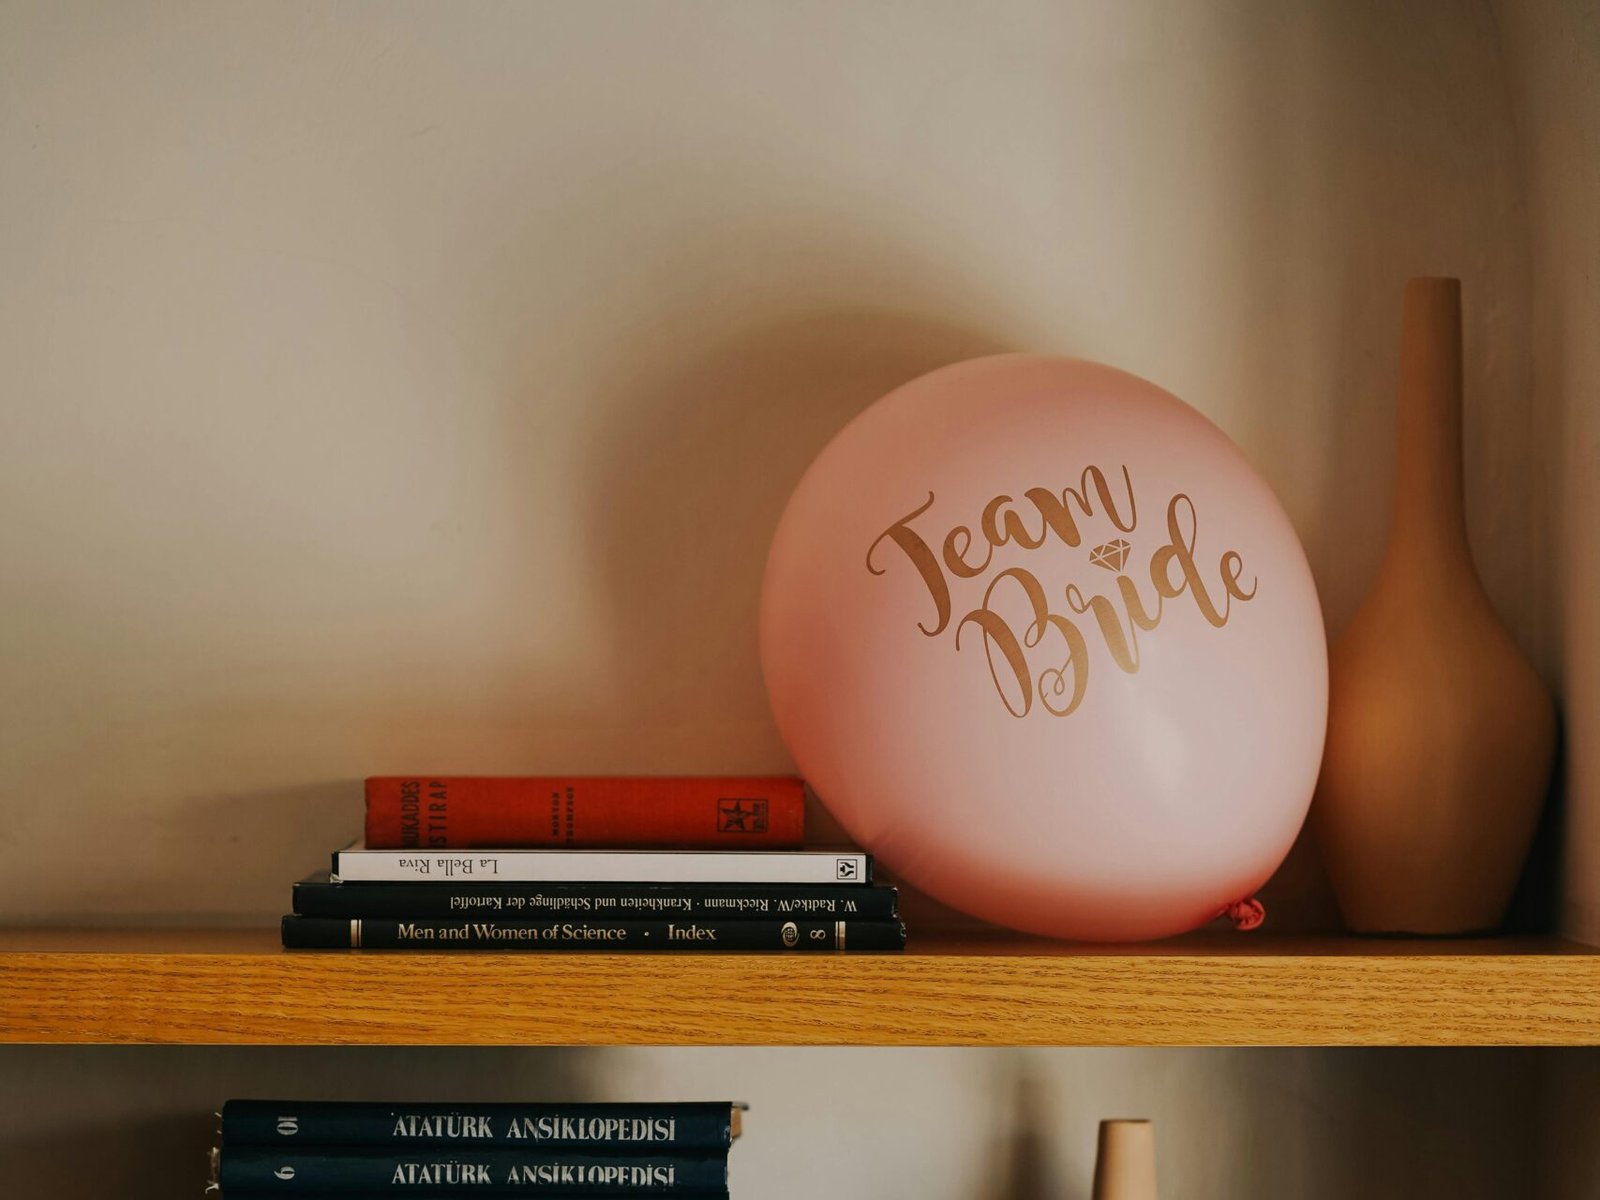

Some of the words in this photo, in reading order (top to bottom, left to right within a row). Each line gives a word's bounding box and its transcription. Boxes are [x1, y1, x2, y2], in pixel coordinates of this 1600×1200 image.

[866, 464, 1136, 638] Team
[955, 493, 1257, 718] Bride
[398, 859, 430, 874] Riva
[437, 859, 473, 877] Bella
[479, 859, 498, 874] La
[450, 896, 502, 910] Kartoffel
[506, 896, 526, 910] der
[529, 893, 591, 911] Schädlinge
[594, 897, 617, 910] und
[620, 897, 692, 911] Krankheiten
[704, 898, 769, 912] Rieckmann
[773, 898, 836, 912] Radtke/W.
[841, 898, 857, 912] W.
[398, 923, 434, 939] Men
[438, 923, 469, 939] and
[472, 923, 538, 940] Women
[541, 924, 561, 940] of
[561, 923, 627, 940] Science
[668, 924, 716, 940] Index
[276, 1116, 298, 1136] 10
[393, 1112, 494, 1139] ATATÜRK
[392, 1161, 491, 1185] ATATÜRK
